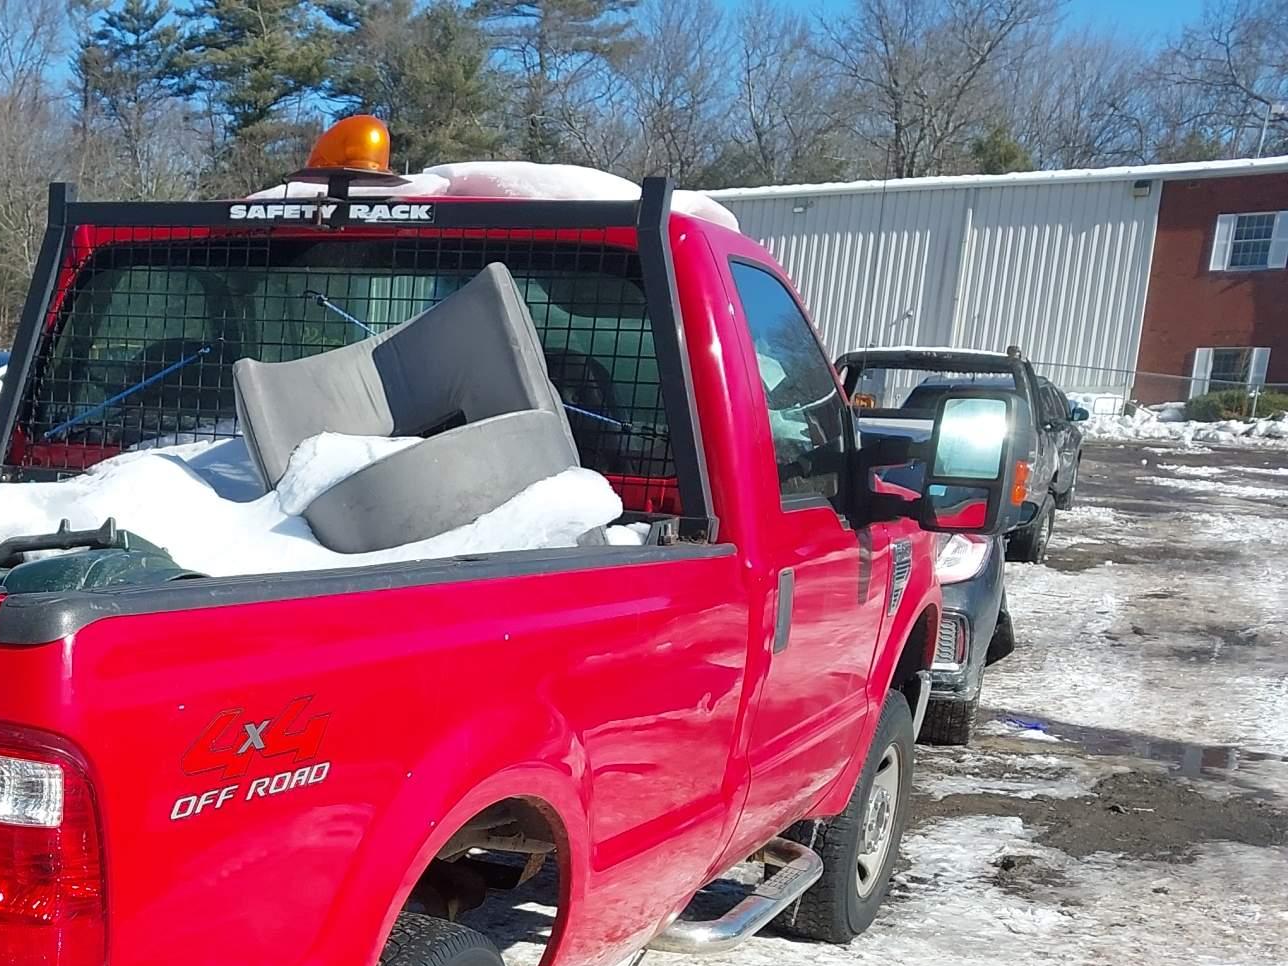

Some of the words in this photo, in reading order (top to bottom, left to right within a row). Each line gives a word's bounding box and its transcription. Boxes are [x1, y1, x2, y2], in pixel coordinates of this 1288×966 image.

[229, 204, 337, 220] SAFETY
[348, 204, 433, 221] RACK
[169, 784, 240, 821] OFF
[244, 761, 331, 802] ROAD
